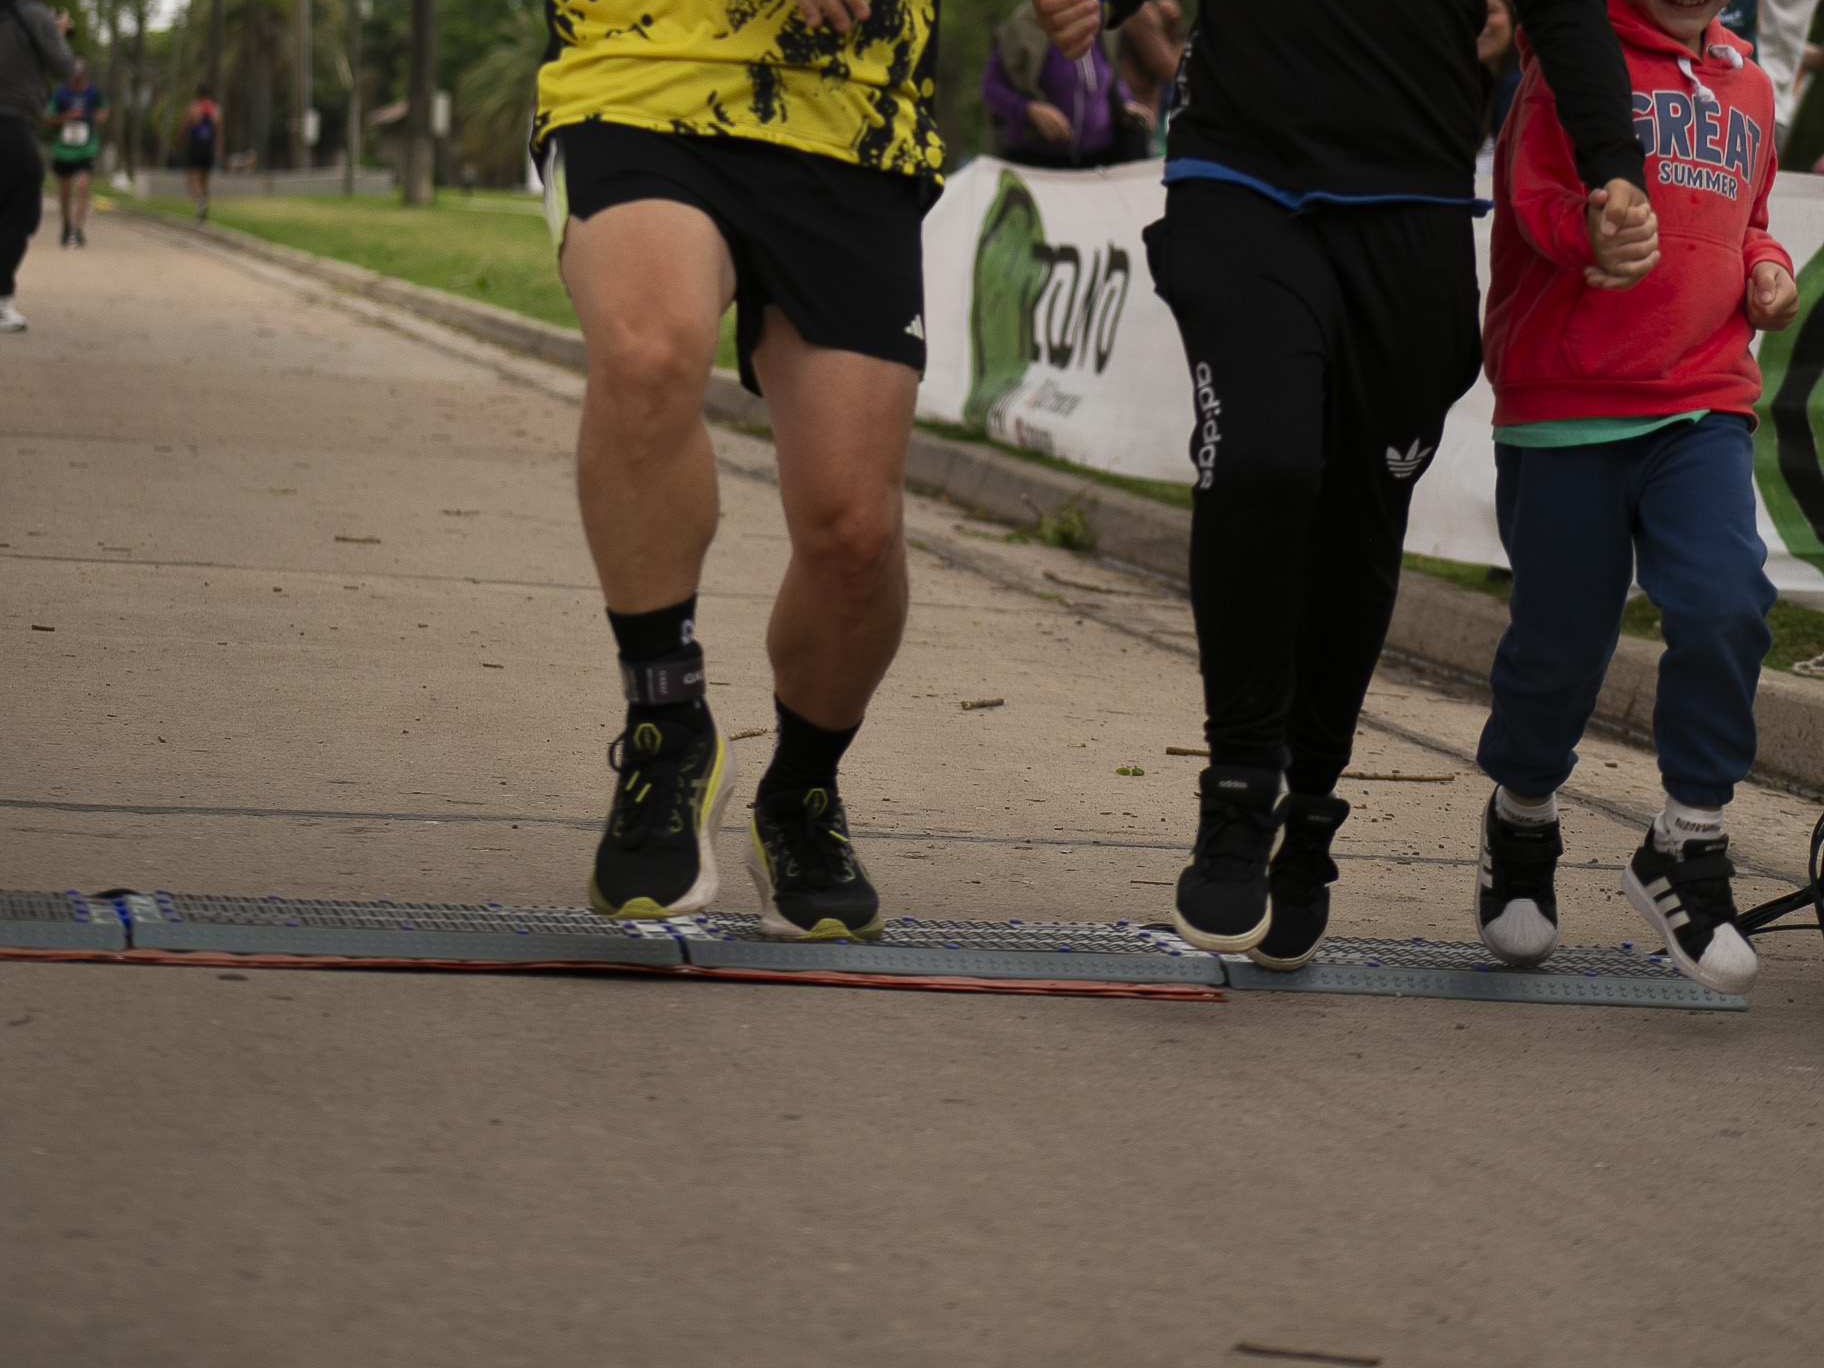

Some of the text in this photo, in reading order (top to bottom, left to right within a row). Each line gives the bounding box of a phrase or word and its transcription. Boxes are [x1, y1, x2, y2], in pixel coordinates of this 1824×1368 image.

[1631, 89, 1761, 188] GREAT
[1658, 161, 1739, 201] SUMMER
[1195, 360, 1223, 490] adidas
